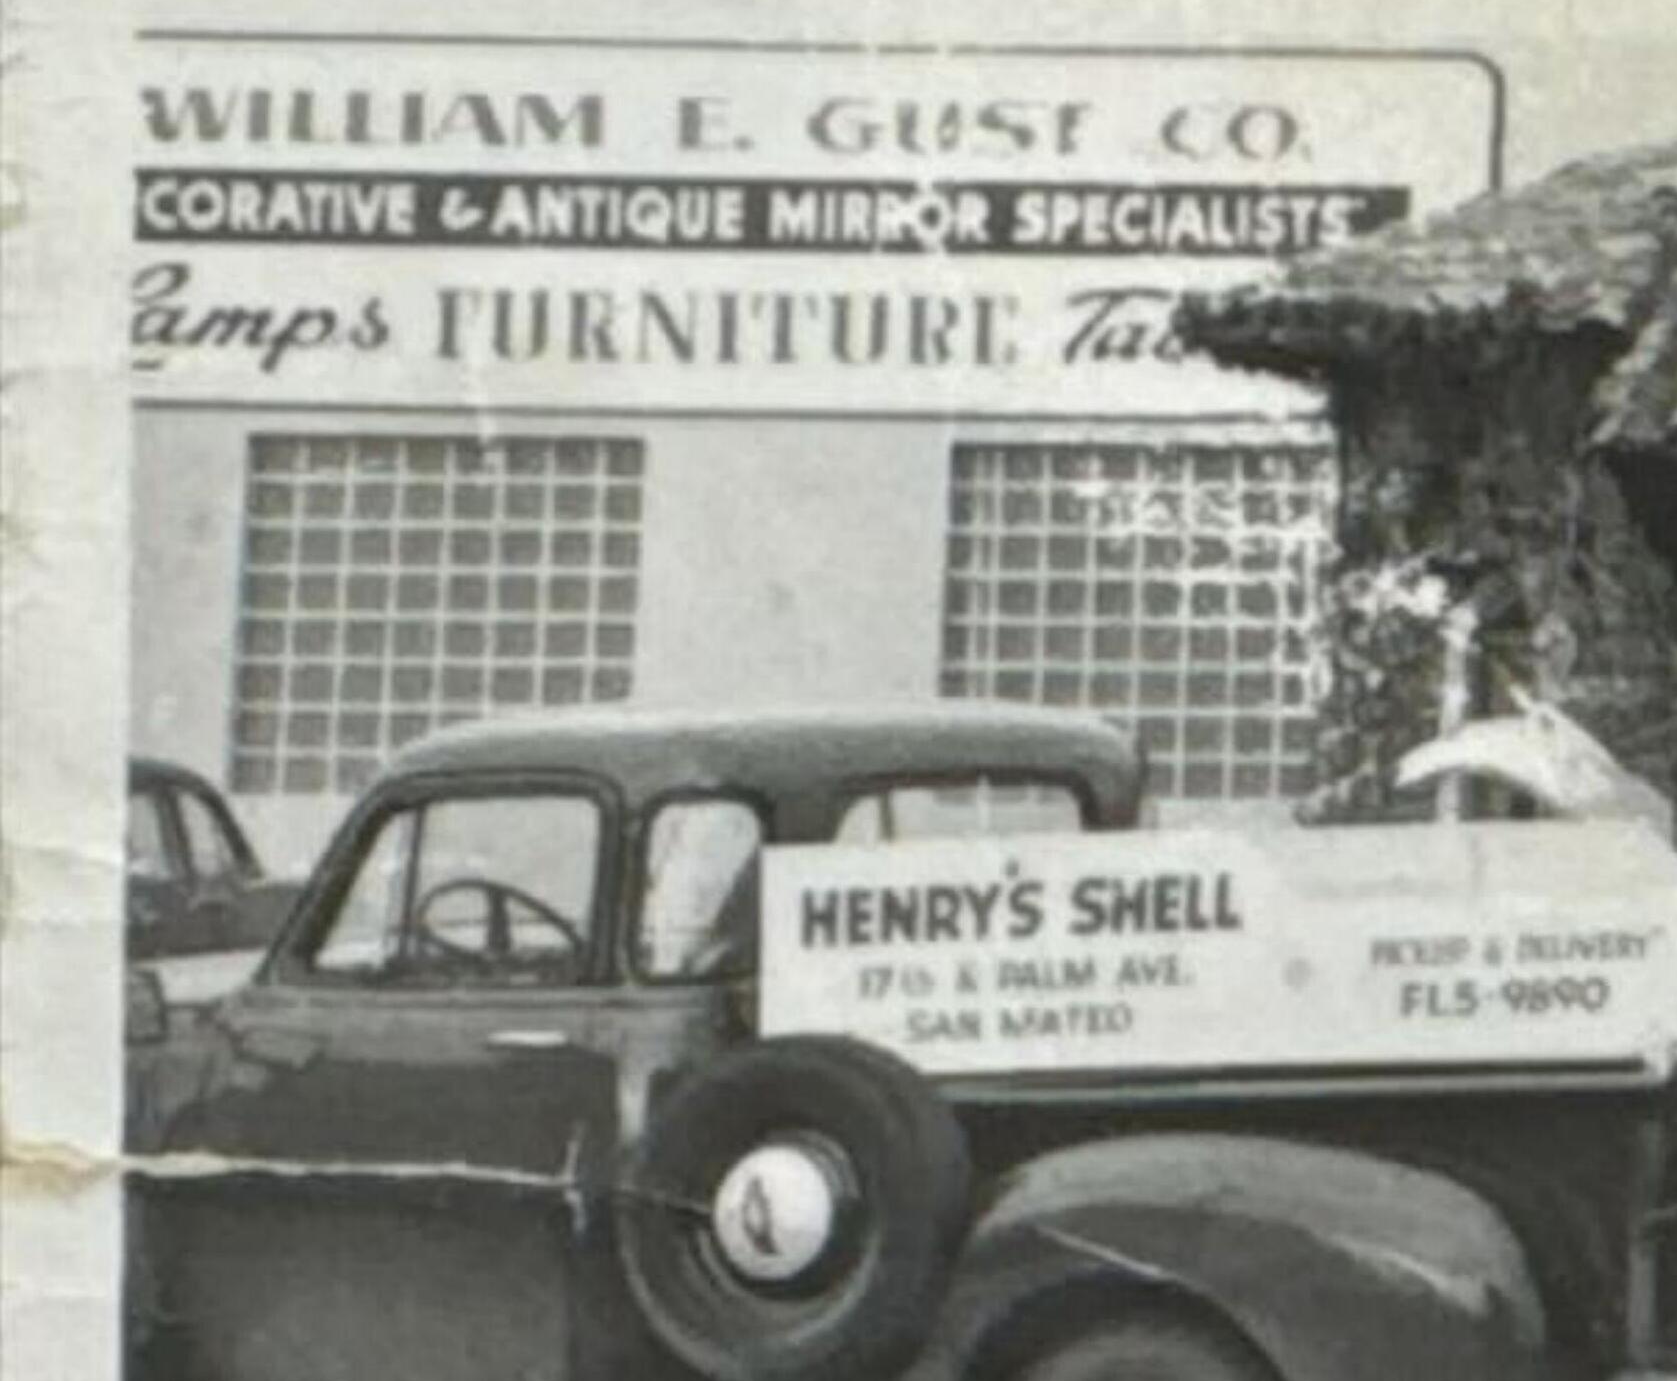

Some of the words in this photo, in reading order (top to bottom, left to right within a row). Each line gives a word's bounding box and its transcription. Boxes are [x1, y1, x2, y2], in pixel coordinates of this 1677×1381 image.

[139, 87, 605, 146] WILLIAM
[674, 96, 756, 151] E.
[806, 98, 1094, 156] GUST
[138, 178, 416, 236] CORATIVE
[440, 189, 482, 232] &
[490, 190, 745, 242] ANTIQUE
[768, 196, 990, 244] MIRROR
[1012, 192, 1368, 246] SPECIALISTS
[434, 286, 1020, 368] FURNITURE
[800, 858, 1043, 950] HENRY'S
[1069, 872, 1242, 936] SHELL
[999, 956, 1097, 990] PALM
[905, 1010, 982, 1041] SAN
